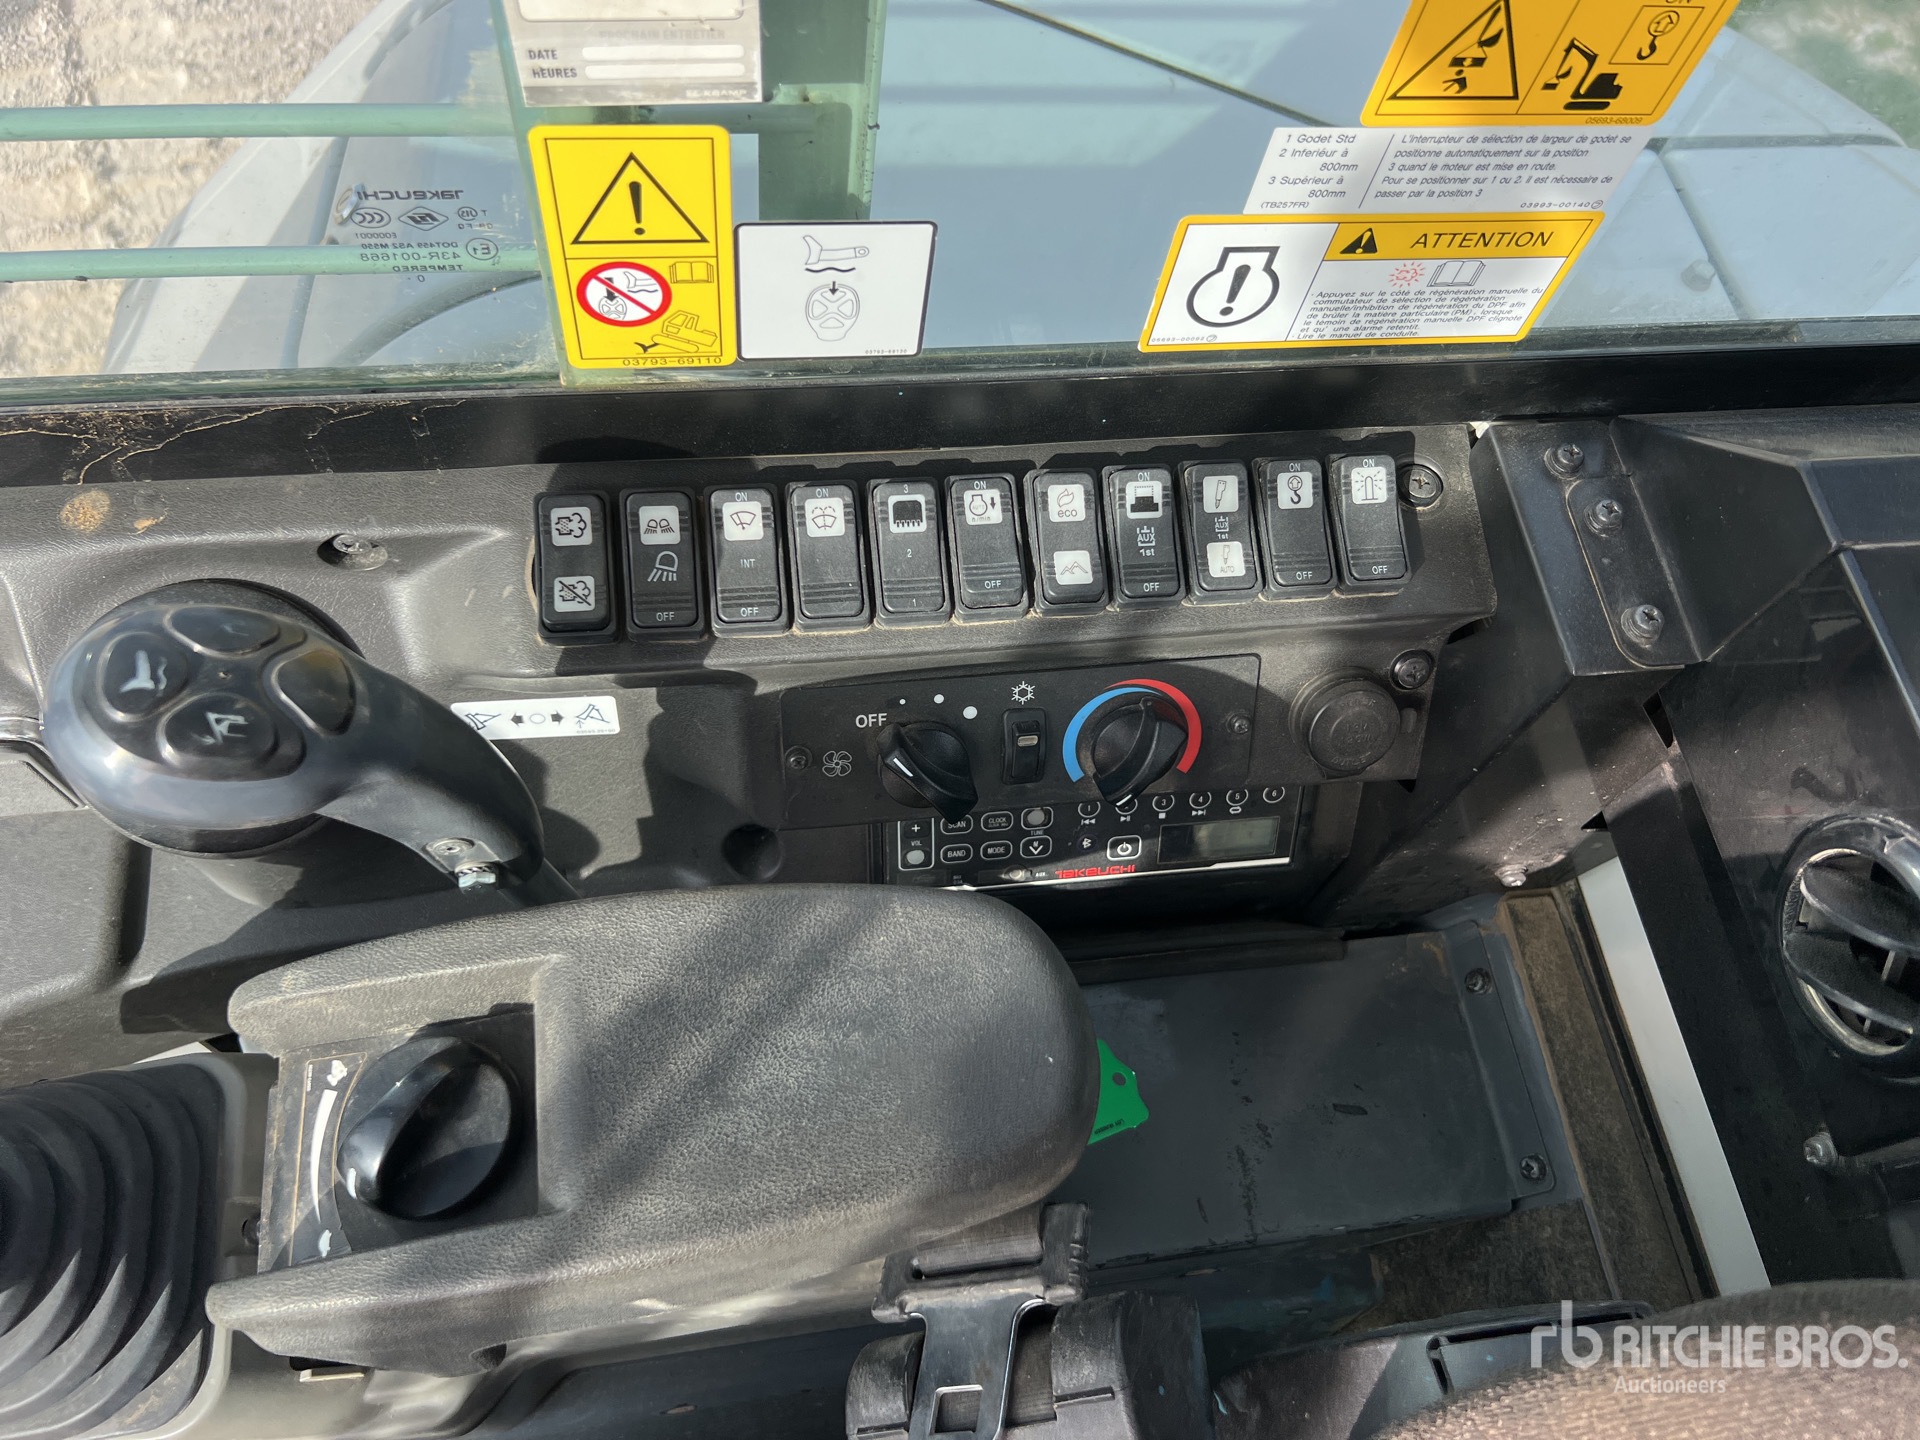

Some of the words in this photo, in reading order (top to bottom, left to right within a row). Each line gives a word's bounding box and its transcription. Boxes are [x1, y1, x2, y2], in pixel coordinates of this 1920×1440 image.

[528, 49, 558, 60] DATE
[532, 68, 578, 79] HEURES
[1286, 134, 1292, 144] 1
[1297, 134, 1332, 144] Godet
[1336, 134, 1356, 144] Std
[1466, 135, 1480, 144] de
[1481, 134, 1523, 144] sélection
[1526, 134, 1538, 144] de
[1540, 134, 1574, 145] largeur
[1575, 134, 1588, 144] de
[1590, 134, 1618, 145] godet
[1619, 136, 1632, 144] se
[1279, 149, 1287, 158] 2
[1341, 148, 1348, 158] à
[1394, 149, 1443, 158] positionne
[1445, 149, 1522, 159] automatiquement
[1524, 150, 1540, 158] sur
[1541, 148, 1550, 158] la
[1552, 148, 1590, 158] position
[1320, 162, 1358, 172] 800mm
[1388, 162, 1396, 172] 3
[1398, 162, 1428, 172] quand
[1429, 162, 1438, 172] le
[1440, 163, 1473, 172] moteur
[1475, 163, 1490, 172] est
[1492, 162, 1514, 172] mise
[1530, 162, 1556, 171] route.
[1268, 176, 1276, 185] 3
[1280, 176, 1334, 186] Supérieur
[1336, 176, 1344, 185] à
[1382, 176, 1404, 184] Pour
[1420, 176, 1470, 186] positionner
[1491, 176, 1498, 184] 1
[1534, 176, 1549, 184] est
[1550, 174, 1598, 184] nécessaire
[1600, 176, 1613, 184] de
[1308, 190, 1346, 198] 800mm
[1374, 190, 1406, 198] passer
[1407, 190, 1424, 198] par
[1426, 190, 1436, 198] la
[1436, 189, 1474, 198] position
[1475, 188, 1483, 198] 3
[1260, 201, 1310, 210] (TB257FR)
[1410, 232, 1555, 248] ATTENTION
[1313, 298, 1375, 306] commutateur
[1310, 304, 1394, 312] manuelle/inhibition
[1307, 312, 1319, 320] de
[1400, 310, 1451, 318] particulaire
[1480, 308, 1513, 316] lorsque
[1297, 332, 1314, 340] Lire
[622, 357, 722, 366] 03793-69110
[1289, 463, 1301, 472] ON
[1363, 459, 1375, 468] ON
[1137, 472, 1150, 482] ON
[903, 484, 909, 494] 3
[974, 481, 987, 490] ON
[734, 492, 748, 502] ON
[816, 488, 829, 498] ON
[1057, 509, 1078, 518] eco
[1136, 533, 1156, 542] AUX
[906, 549, 912, 558] 2
[1140, 548, 1156, 556] 1st
[740, 558, 756, 568] INT
[1372, 566, 1388, 574] OFF
[1296, 572, 1312, 581] OFF
[985, 580, 1002, 589] OFF
[1143, 583, 1160, 592] OFF
[656, 612, 675, 622] OFF
[740, 608, 760, 617] OFF
[855, 712, 888, 729] OFF
[1161, 798, 1166, 806] 3
[1198, 796, 1204, 804] 4
[1234, 792, 1240, 800] 5
[1271, 790, 1277, 798] 6
[948, 850, 966, 858] BAND
[988, 846, 1006, 854] MODE
[1055, 864, 1136, 879] TAKEUCHI
